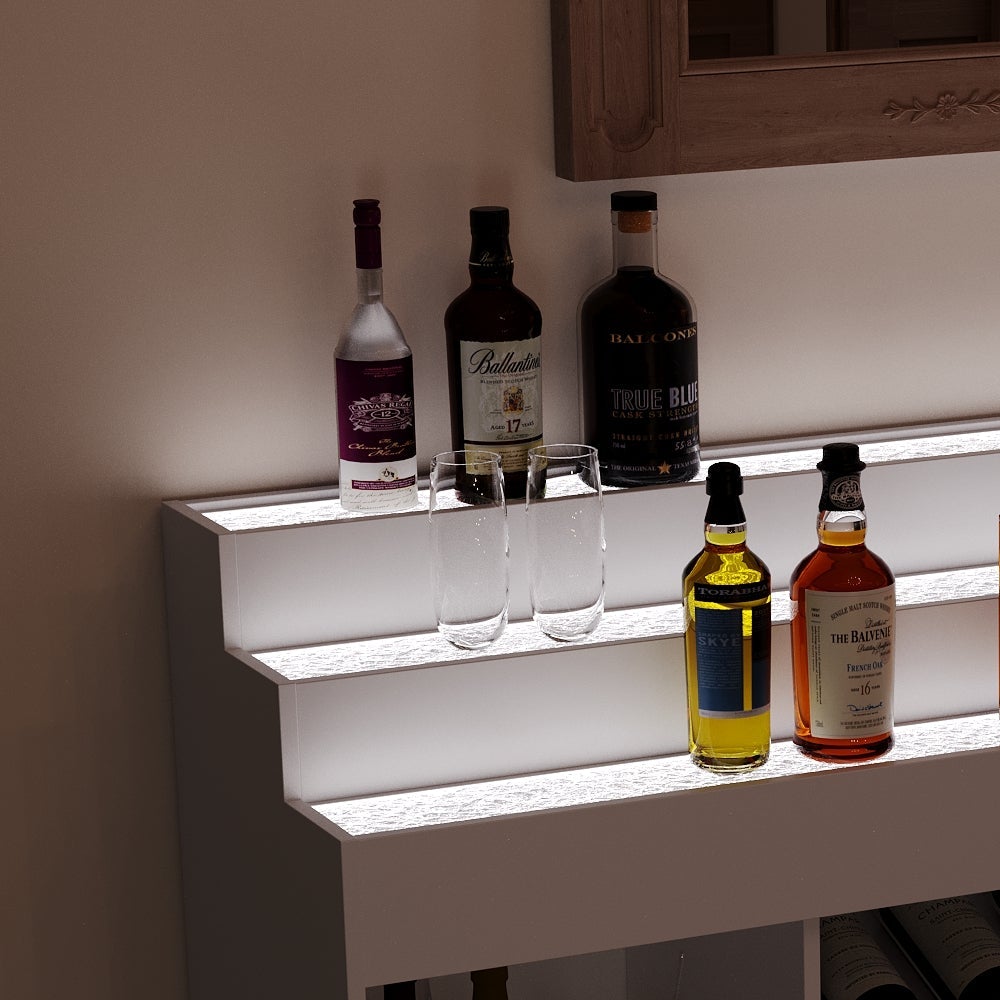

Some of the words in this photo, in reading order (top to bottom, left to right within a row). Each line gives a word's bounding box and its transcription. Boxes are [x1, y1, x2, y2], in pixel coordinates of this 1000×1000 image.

[608, 326, 697, 344] BALCONES
[610, 388, 663, 411] TRUE
[669, 381, 698, 409] BLUE
[351, 403, 386, 412] CHIVAS
[611, 410, 645, 419] CASK
[506, 418, 521, 433] 17
[848, 603, 862, 615] MALT
[862, 601, 880, 610] SCOTCH
[697, 636, 742, 647] SKYE
[830, 633, 849, 644] THE
[850, 625, 892, 643] BALVENIE
[846, 662, 872, 673] FRENCH
[860, 680, 871, 696] 16
